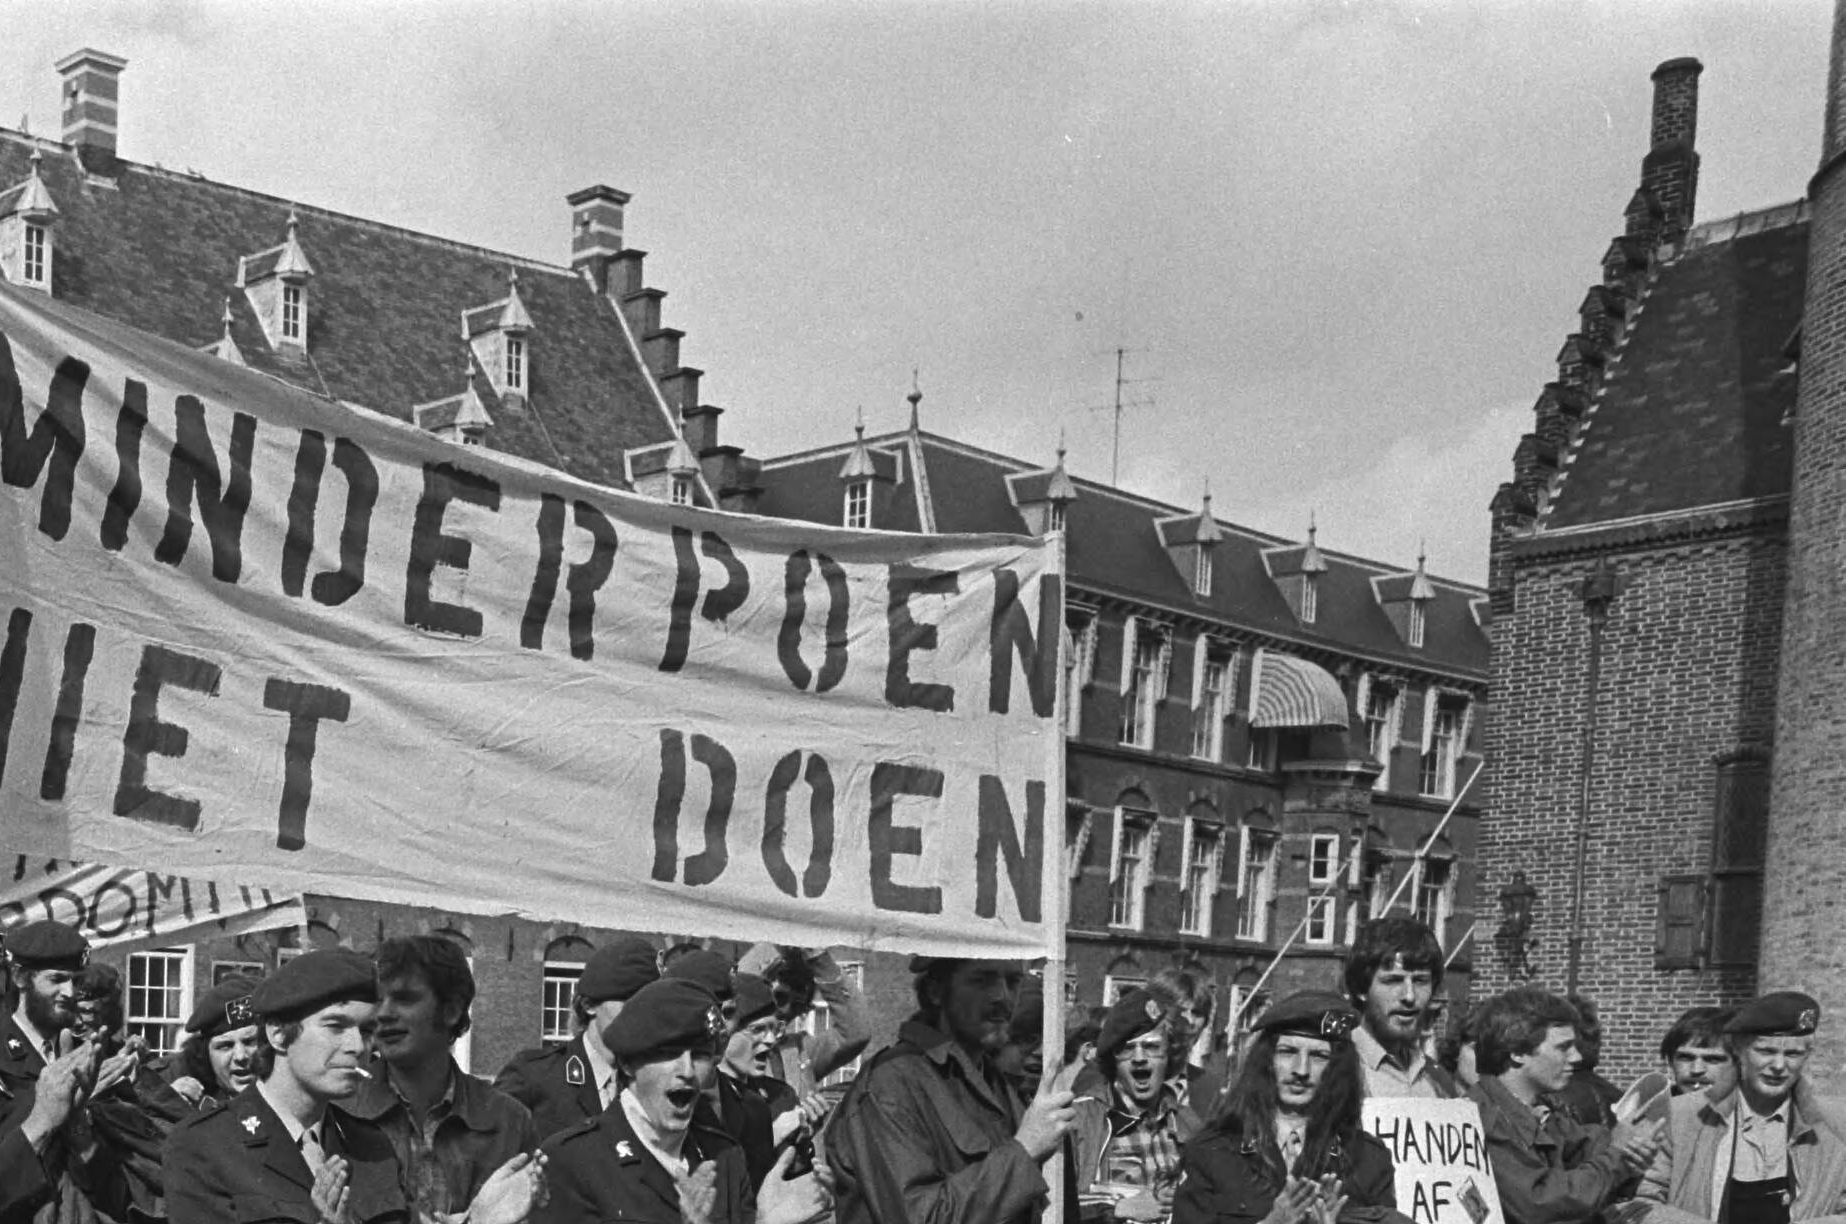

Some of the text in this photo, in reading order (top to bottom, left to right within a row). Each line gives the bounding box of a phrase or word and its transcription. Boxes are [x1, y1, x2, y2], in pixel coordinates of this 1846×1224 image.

[658, 525, 1062, 718] POEN
[651, 728, 1047, 923] DOEN
[1375, 1115, 1490, 1176] HANDEN
[1412, 1180, 1453, 1224] AF
